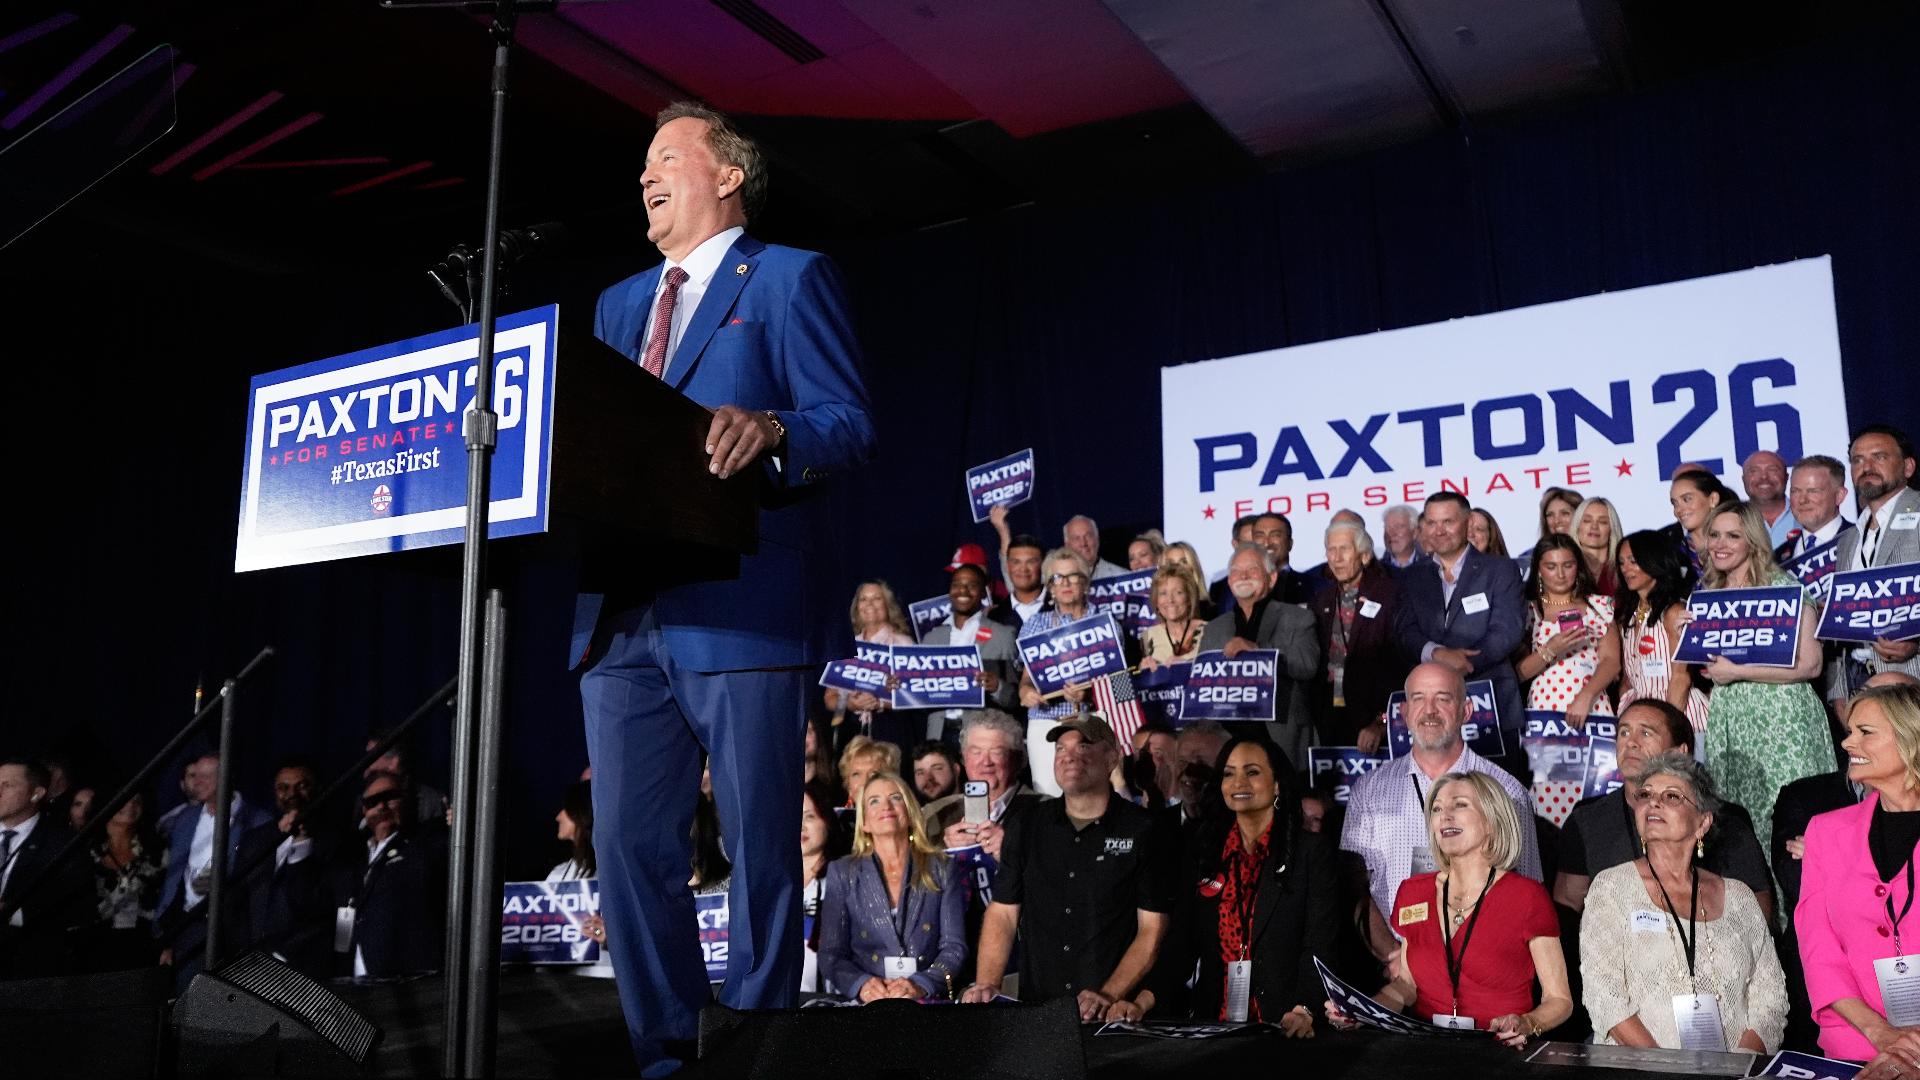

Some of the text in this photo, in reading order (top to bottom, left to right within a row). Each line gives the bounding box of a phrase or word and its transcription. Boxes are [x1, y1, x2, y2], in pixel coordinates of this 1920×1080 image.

[269, 370, 458, 448] PAXTON
[1193, 358, 1804, 493] PAXTON 26
[283, 423, 437, 466] FOR SENATE
[330, 446, 440, 485] #TexasFirst
[970, 458, 1031, 489] PAXTON
[982, 481, 1024, 506] 2026
[1235, 463, 1592, 520] FOR SENATE
[1834, 574, 1920, 602] PAXT
[915, 603, 952, 624] PAX
[1098, 601, 1125, 614] 20
[1691, 598, 1798, 621] PAXTON
[1849, 602, 1920, 628] 2026
[1023, 623, 1114, 663] PAXTON
[1701, 628, 1775, 648] 2026
[894, 654, 979, 670] PAXTON
[1044, 651, 1107, 683] 2026
[1190, 660, 1273, 678] PAXTON
[910, 676, 969, 692] 2026
[1138, 685, 1183, 702] TexasF
[1198, 686, 1258, 702] 2026
[1525, 720, 1616, 737] PAXTO
[1543, 745, 1589, 763] 20
[1315, 758, 1392, 775] PAXT
[503, 892, 600, 914] AXTON
[501, 924, 581, 943] 2026
